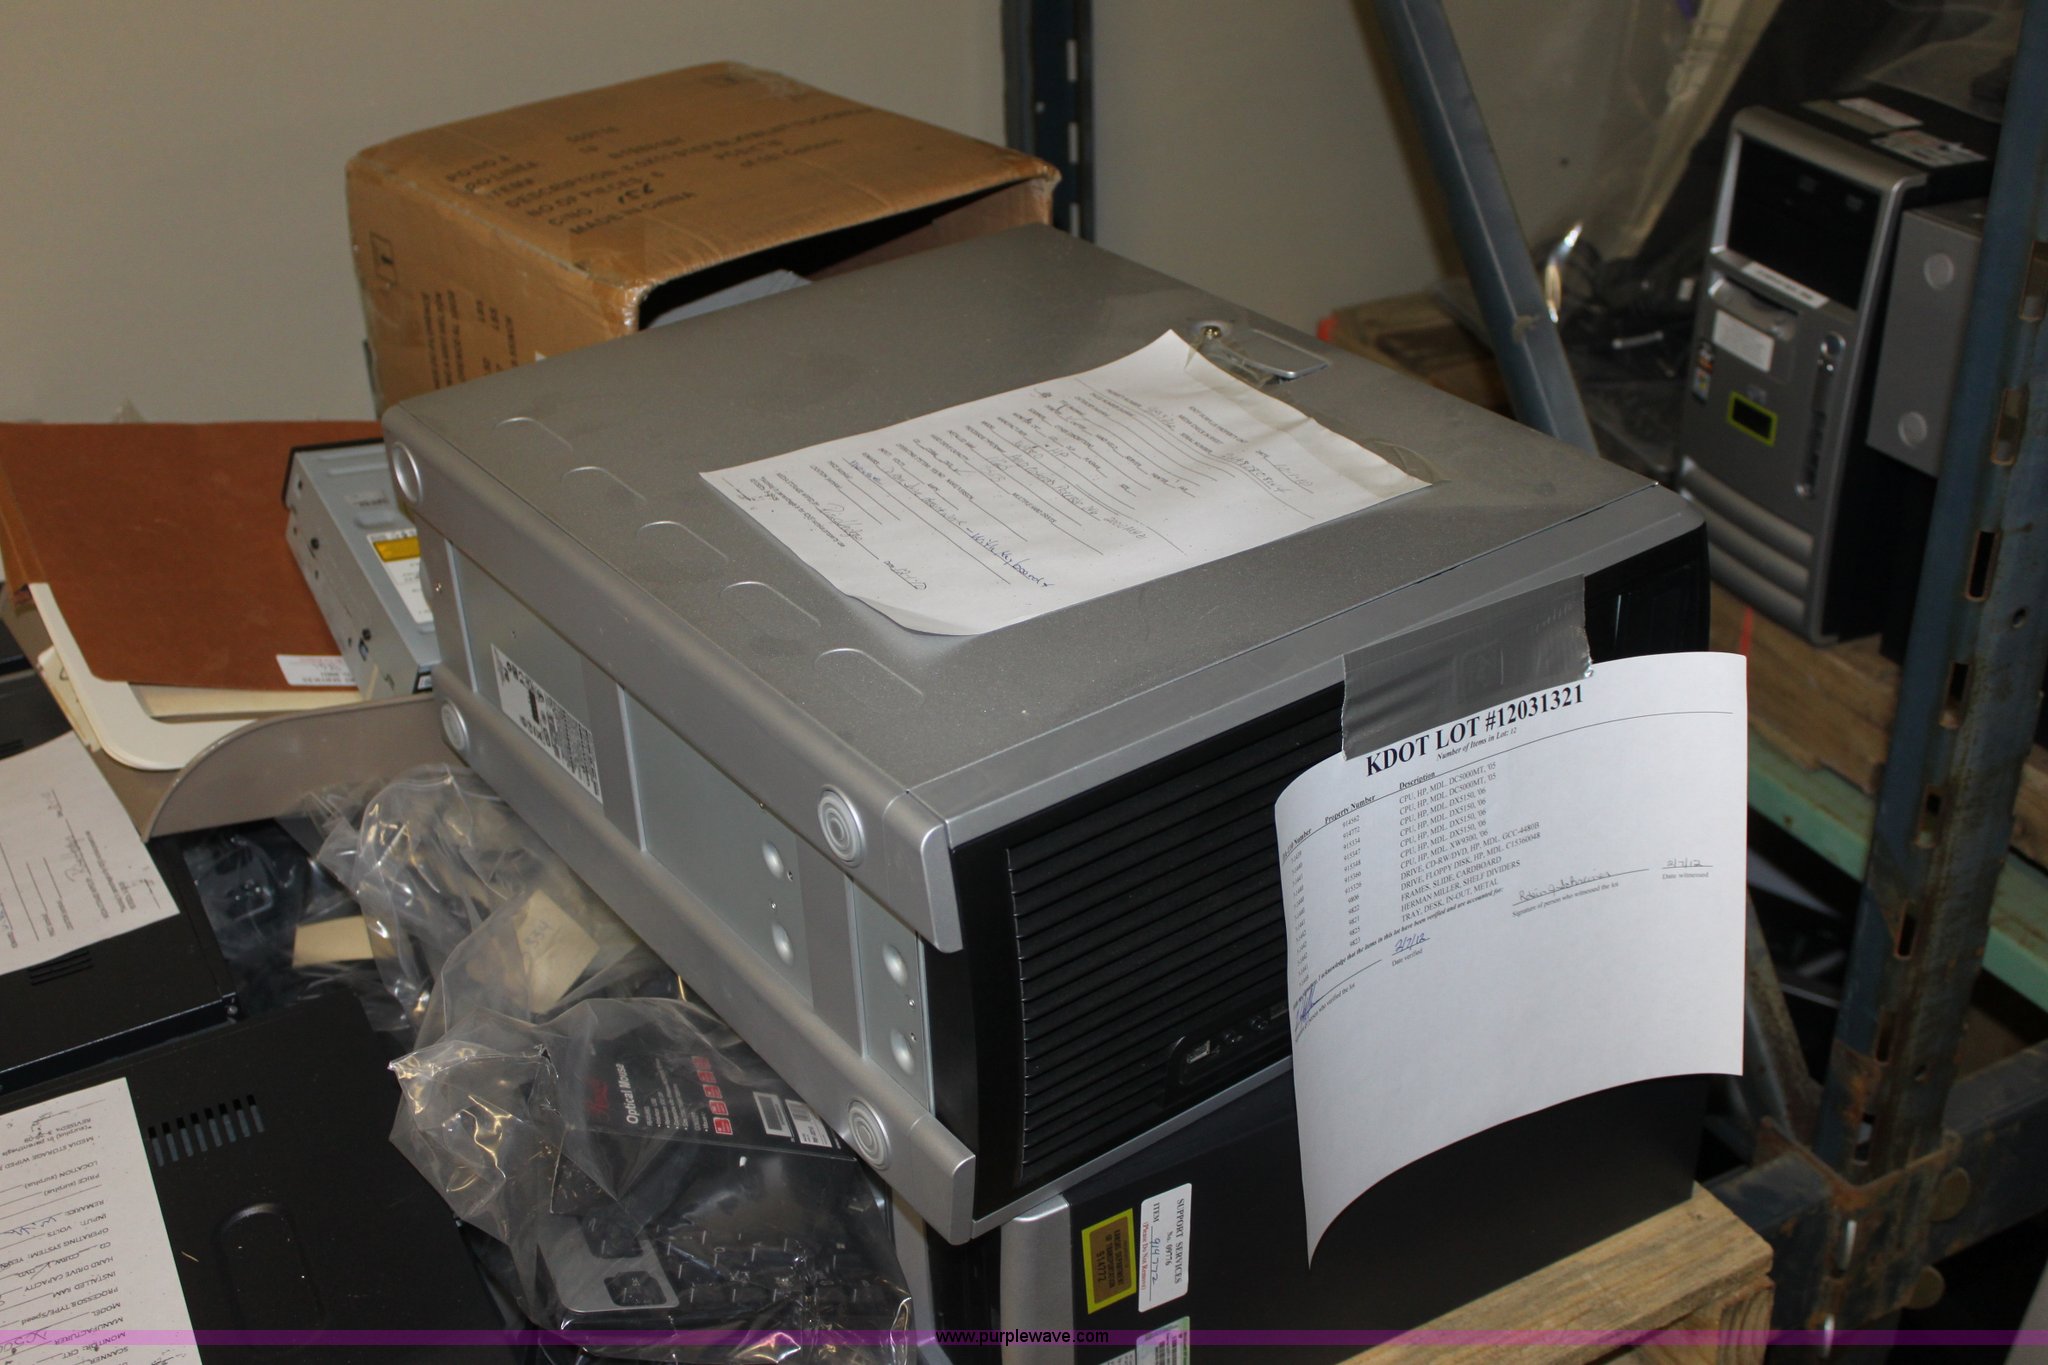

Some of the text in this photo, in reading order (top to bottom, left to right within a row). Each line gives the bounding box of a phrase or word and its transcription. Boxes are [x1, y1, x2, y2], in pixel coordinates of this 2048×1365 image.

[1367, 684, 1583, 776] KDOT LOT #12031321
[1436, 746, 1462, 761] Number
[1469, 737, 1487, 750] Items
[1400, 771, 1435, 791] Description
[1324, 795, 1375, 825] Property Number
[615, 1063, 639, 1125] Optical Mouse
[4, 1136, 94, 1169] MEDIA STORAGE WIPED
[24, 1160, 99, 1190] LOCATION (surplus)
[43, 1173, 100, 1197] PRICE (surplus)
[1152, 1201, 1160, 1223] ITEM
[47, 1224, 72, 1238] VOLTS
[63, 1227, 109, 1248] OPERATING
[1174, 1197, 1185, 1285] SUPPORT SERVICES
[1165, 1243, 1173, 1267] 09776
[24, 1256, 114, 1293] HARD DRIVE CAPACITY
[74, 1271, 116, 1290] INSTALLED
[21, 1303, 71, 1326] TYPE/Speed
[93, 1302, 121, 1317] MODEL
[54, 1316, 124, 1345] MANUFACTURER
[63, 1348, 79, 1359] CRT
[89, 1346, 129, 1364] SCANNER
